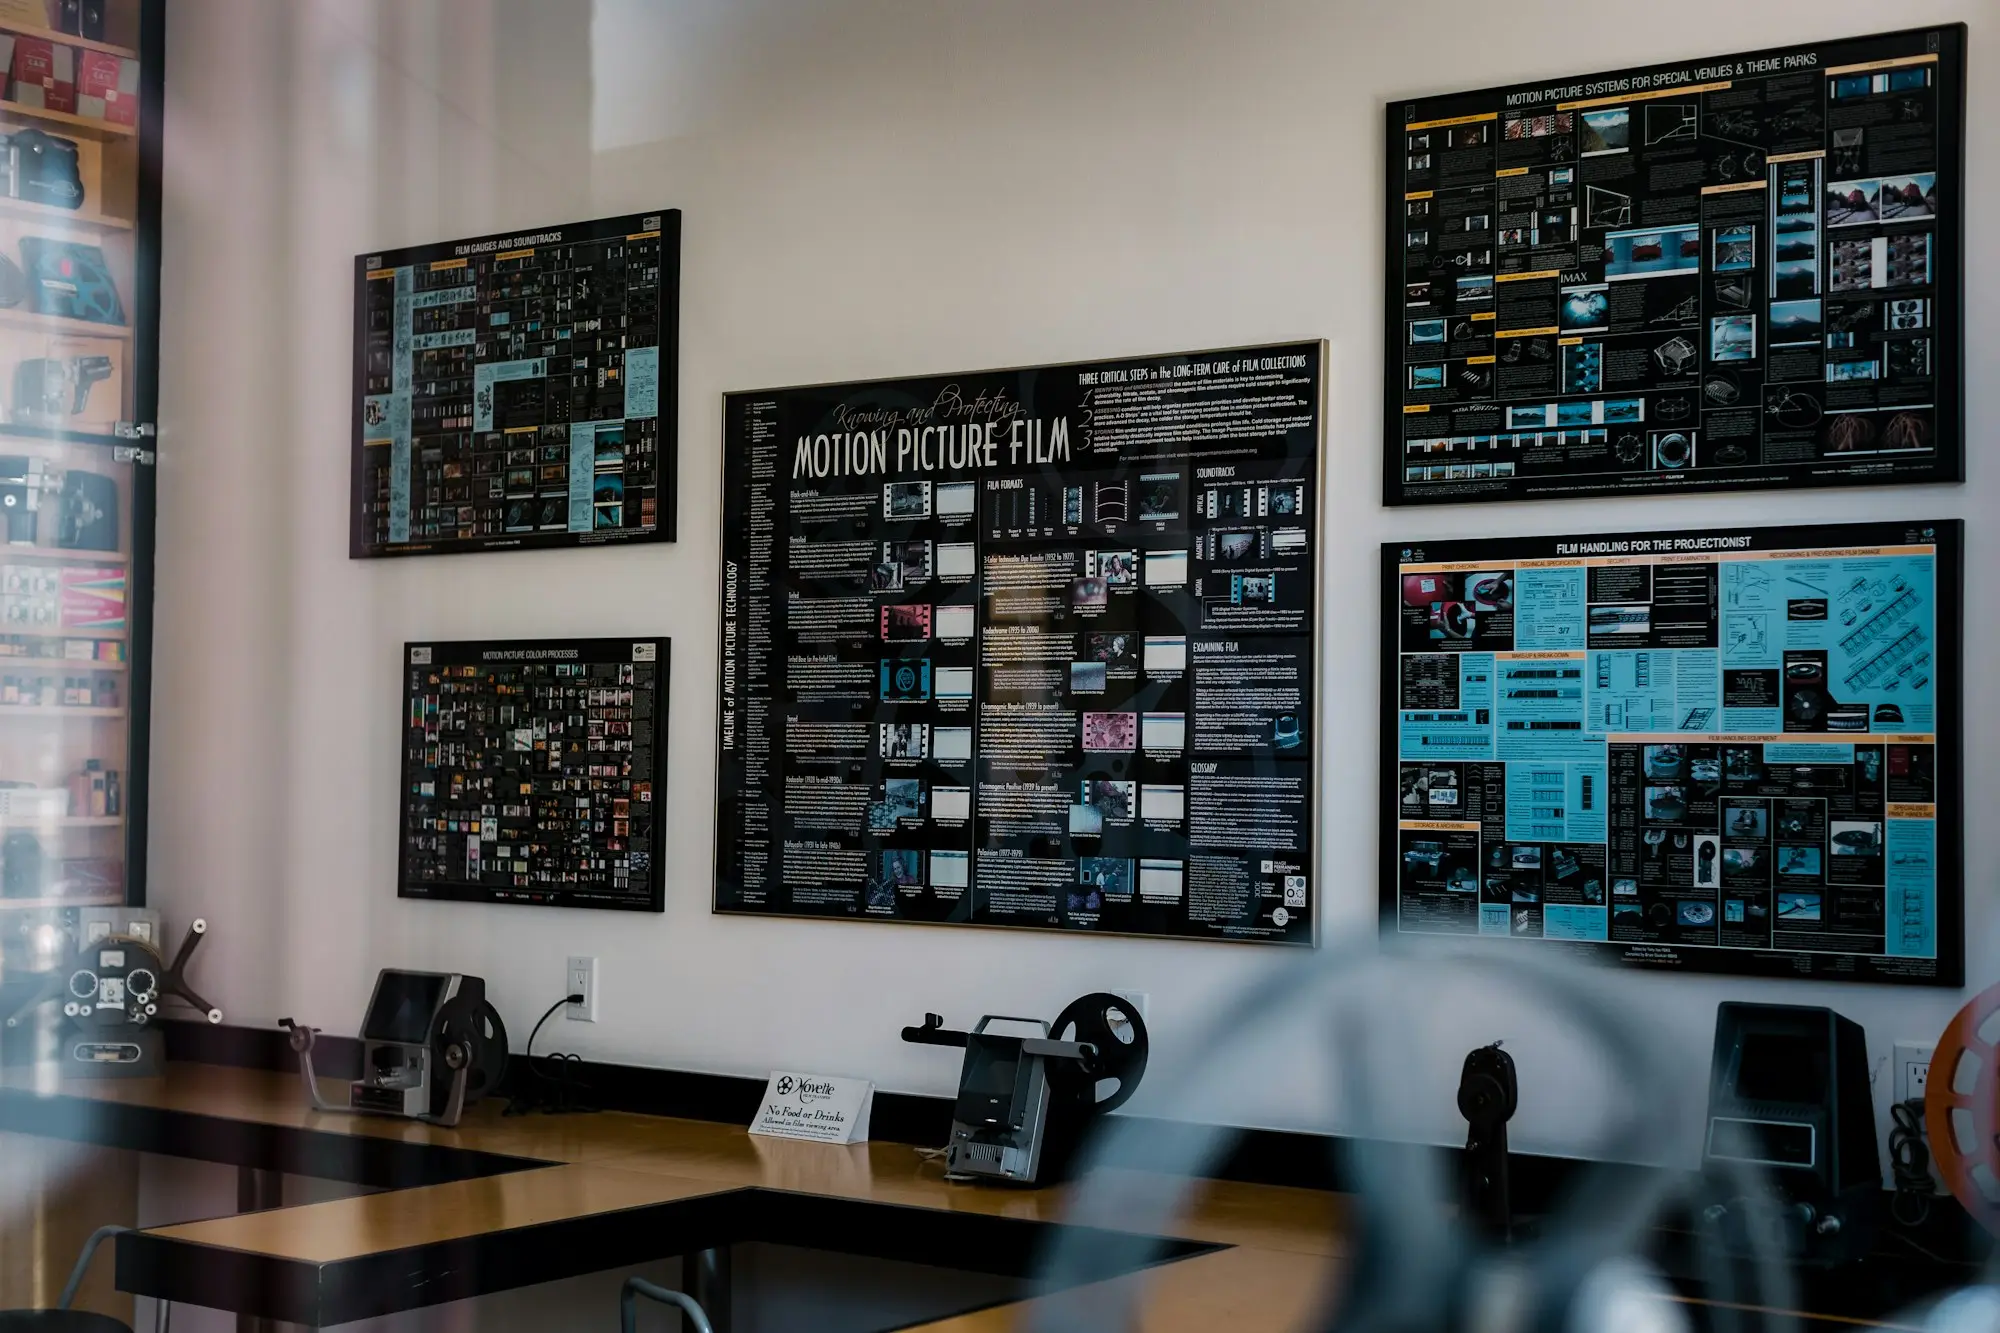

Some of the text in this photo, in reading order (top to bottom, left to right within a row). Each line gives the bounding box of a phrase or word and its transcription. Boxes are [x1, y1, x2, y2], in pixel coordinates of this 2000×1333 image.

[1506, 90, 1543, 107] MOTION
[1543, 84, 1583, 102] PICTURE
[1583, 78, 1630, 97] SYSTEMS
[1630, 75, 1650, 90] FOR
[1651, 69, 1692, 87] SPECIAL
[1693, 64, 1734, 82] VENUES
[1734, 62, 1745, 76] &
[1745, 57, 1782, 75] THEME
[1782, 53, 1817, 70] PARKS
[455, 242, 470, 256] FILM
[470, 239, 497, 254] GAUGES
[497, 237, 512, 251] AND
[514, 232, 562, 247] SOUNDTRACKS
[1561, 271, 1588, 283] IMAX
[1079, 355, 1306, 385] THREE CRITICAL STEPS in the LONG-TERM CARE of FILM COLLECTIONS
[1078, 389, 1093, 407] 1
[833, 384, 1027, 446] Knowing and Protecting
[1078, 410, 1092, 427] 2
[793, 416, 1071, 479] MOTION PICTURE FILM
[1077, 430, 1093, 450] 3
[1197, 466, 1235, 478] SOUNDTRACKS
[987, 479, 1023, 490] FILM FORMATS
[1556, 536, 1751, 555] FILM HANDLING FOR THE PROJECTIONIST
[1558, 626, 1570, 635] 3/7
[483, 650, 578, 661] MOTION PICTURE COLOUR PROCESSES
[723, 561, 738, 750] TIMELINE of MOTION PICTURE TECHNOLOGY
[1193, 642, 1239, 652] EXAMINING FILM
[1191, 763, 1218, 773] GLOSSARY
[765, 1105, 845, 1122] No Food or Drinks
[762, 1117, 785, 1125] Allowed
[806, 1121, 828, 1131] viewing
